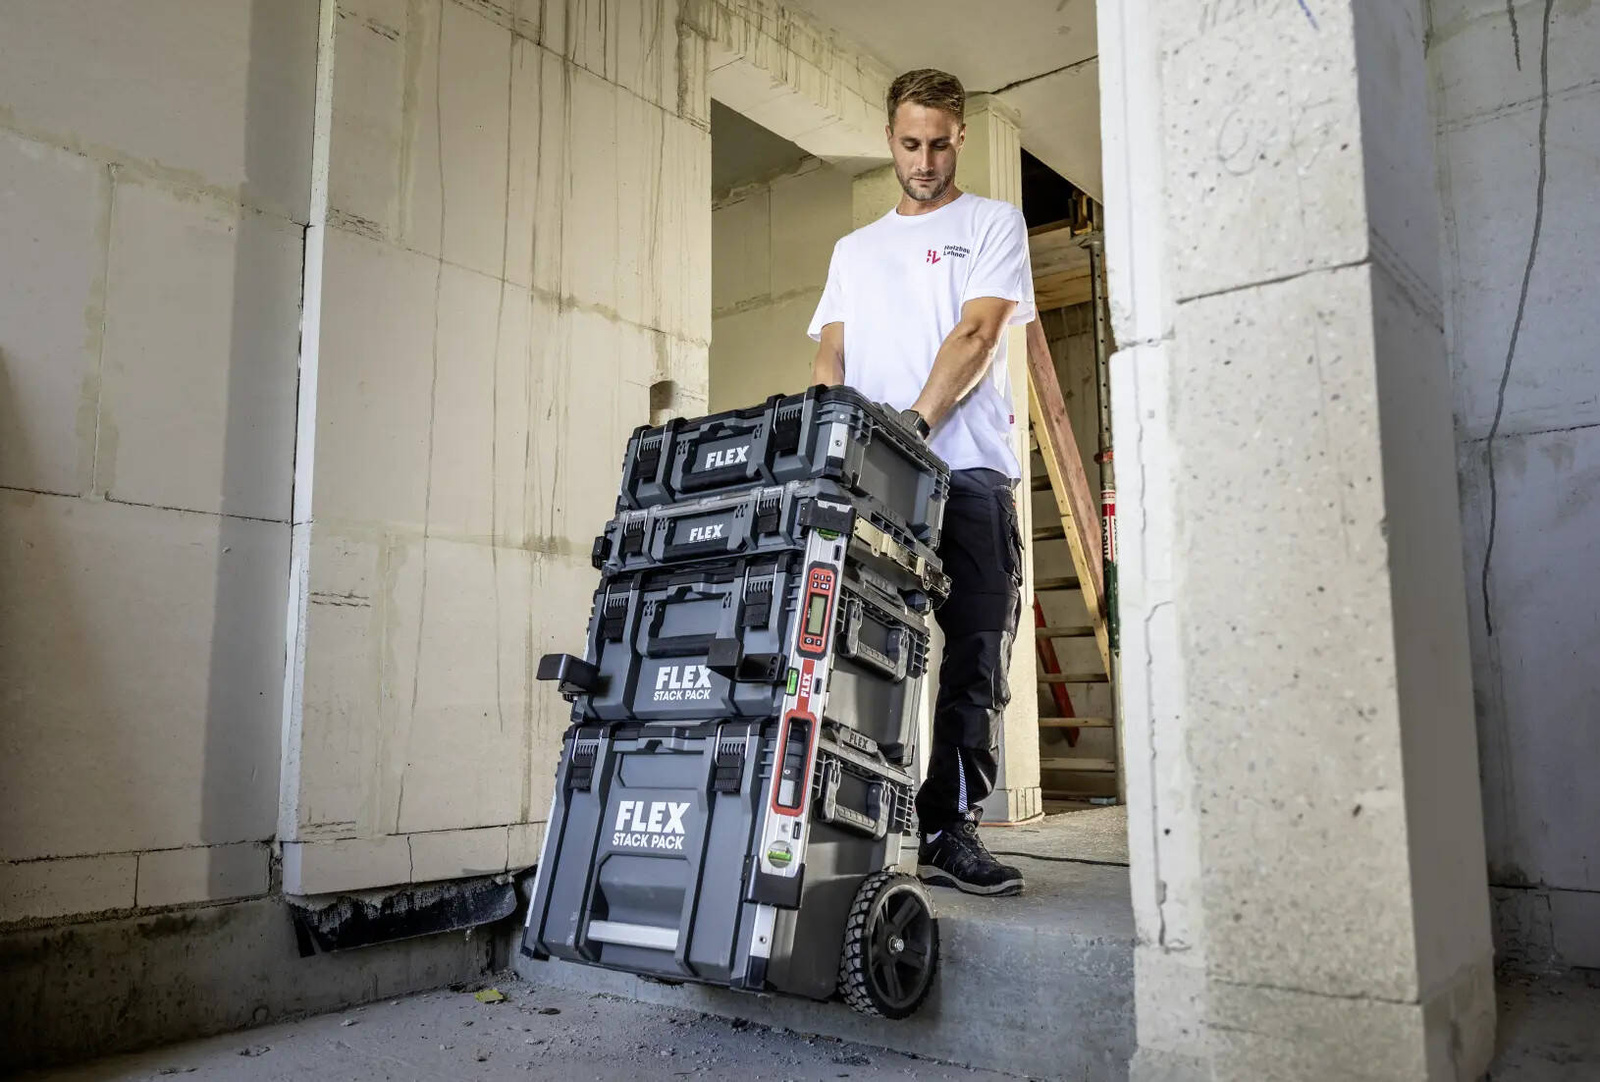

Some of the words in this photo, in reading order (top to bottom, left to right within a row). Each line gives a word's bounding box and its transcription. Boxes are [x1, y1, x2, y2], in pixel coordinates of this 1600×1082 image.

[705, 445, 750, 469] FLEX
[689, 524, 724, 543] FLEX
[655, 664, 712, 690] FLEX
[801, 673, 812, 698] FLEX
[653, 689, 683, 701] STACK
[684, 688, 711, 700] PACK
[849, 732, 869, 750] FLEX
[615, 800, 691, 834] FLEX
[612, 832, 649, 848] STACK
[651, 834, 684, 850] PACK
